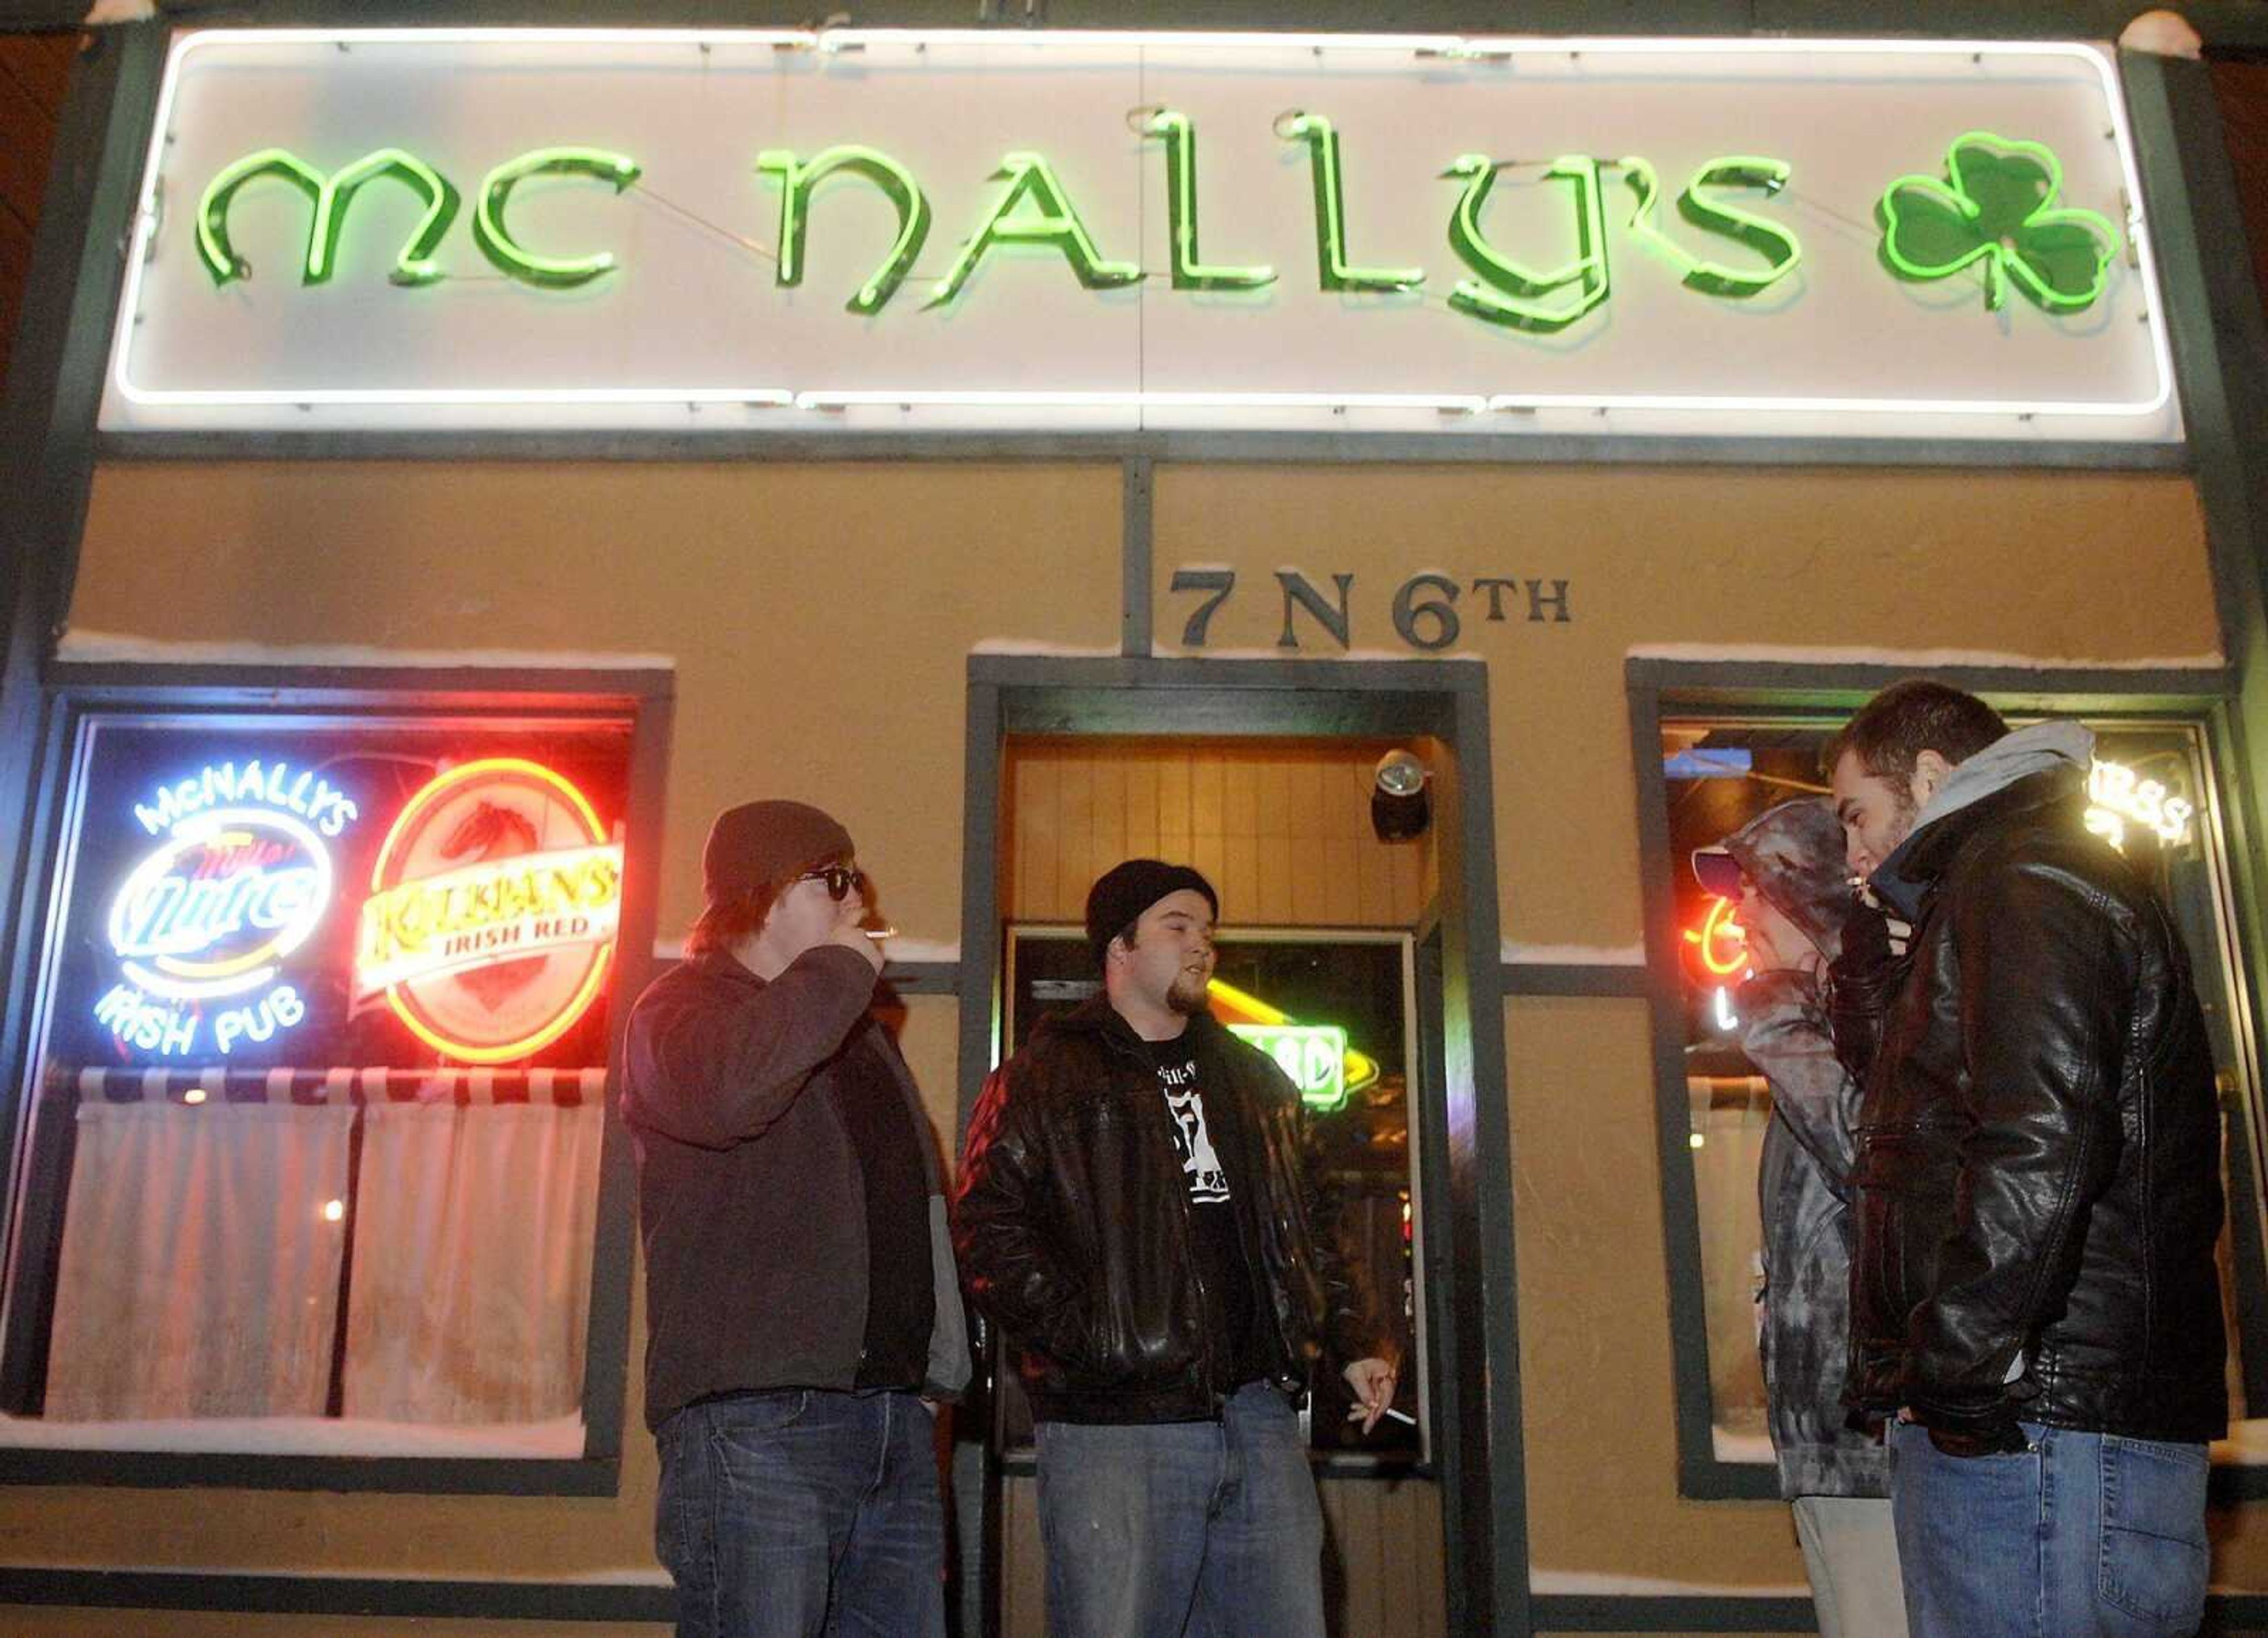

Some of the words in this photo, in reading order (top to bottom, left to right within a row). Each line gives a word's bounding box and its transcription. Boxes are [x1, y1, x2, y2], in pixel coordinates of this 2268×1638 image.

[1170, 570, 1236, 647] 7
[1273, 571, 1354, 650] N
[444, 924, 521, 956] IRISH
[534, 916, 588, 939] RED
[93, 984, 197, 1055] IRISH
[214, 986, 305, 1054] PUB
